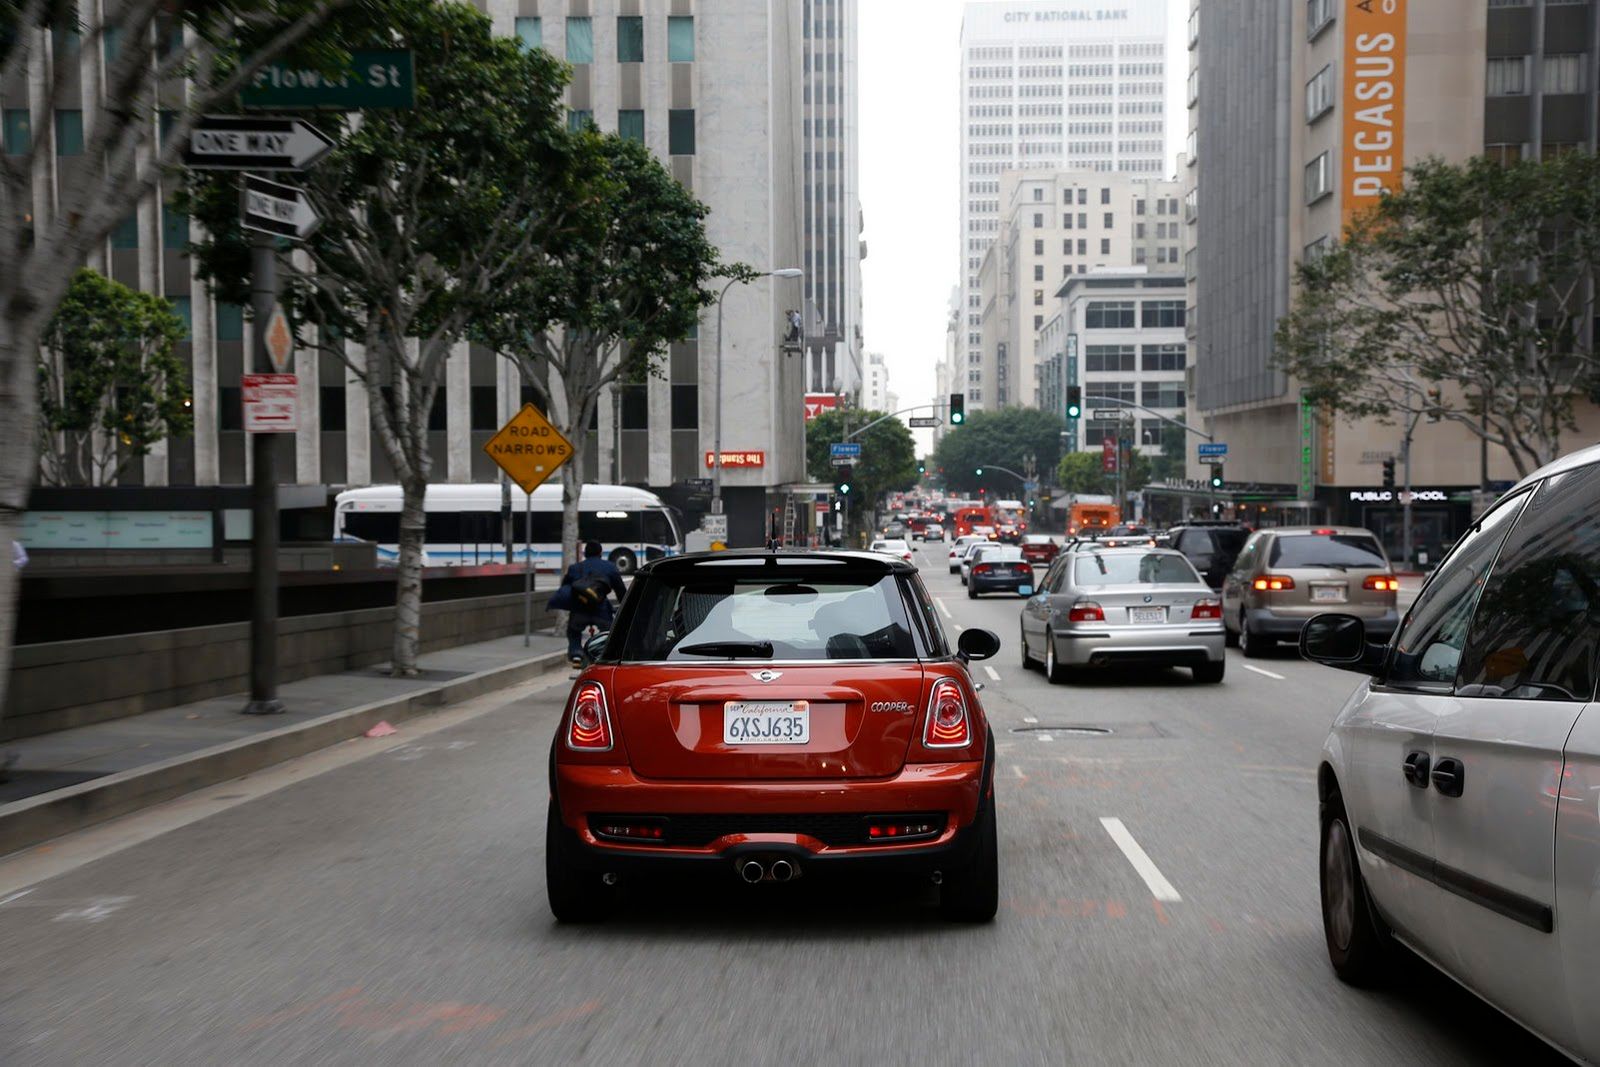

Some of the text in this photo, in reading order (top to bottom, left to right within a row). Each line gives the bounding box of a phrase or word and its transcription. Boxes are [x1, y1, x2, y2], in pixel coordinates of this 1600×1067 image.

[1004, 9, 1128, 22] CITY NATIONAL BANK
[368, 63, 400, 88] St
[197, 132, 290, 154] ONE WAY
[247, 193, 297, 219] ONE WAY
[510, 426, 550, 437] ROAD
[493, 444, 566, 455] NARROWS
[708, 454, 761, 464] The Standd
[1350, 491, 1392, 501] PUBLIC
[742, 704, 792, 716] California
[871, 702, 907, 712] COOPER
[730, 717, 803, 737] 6XSJ635
